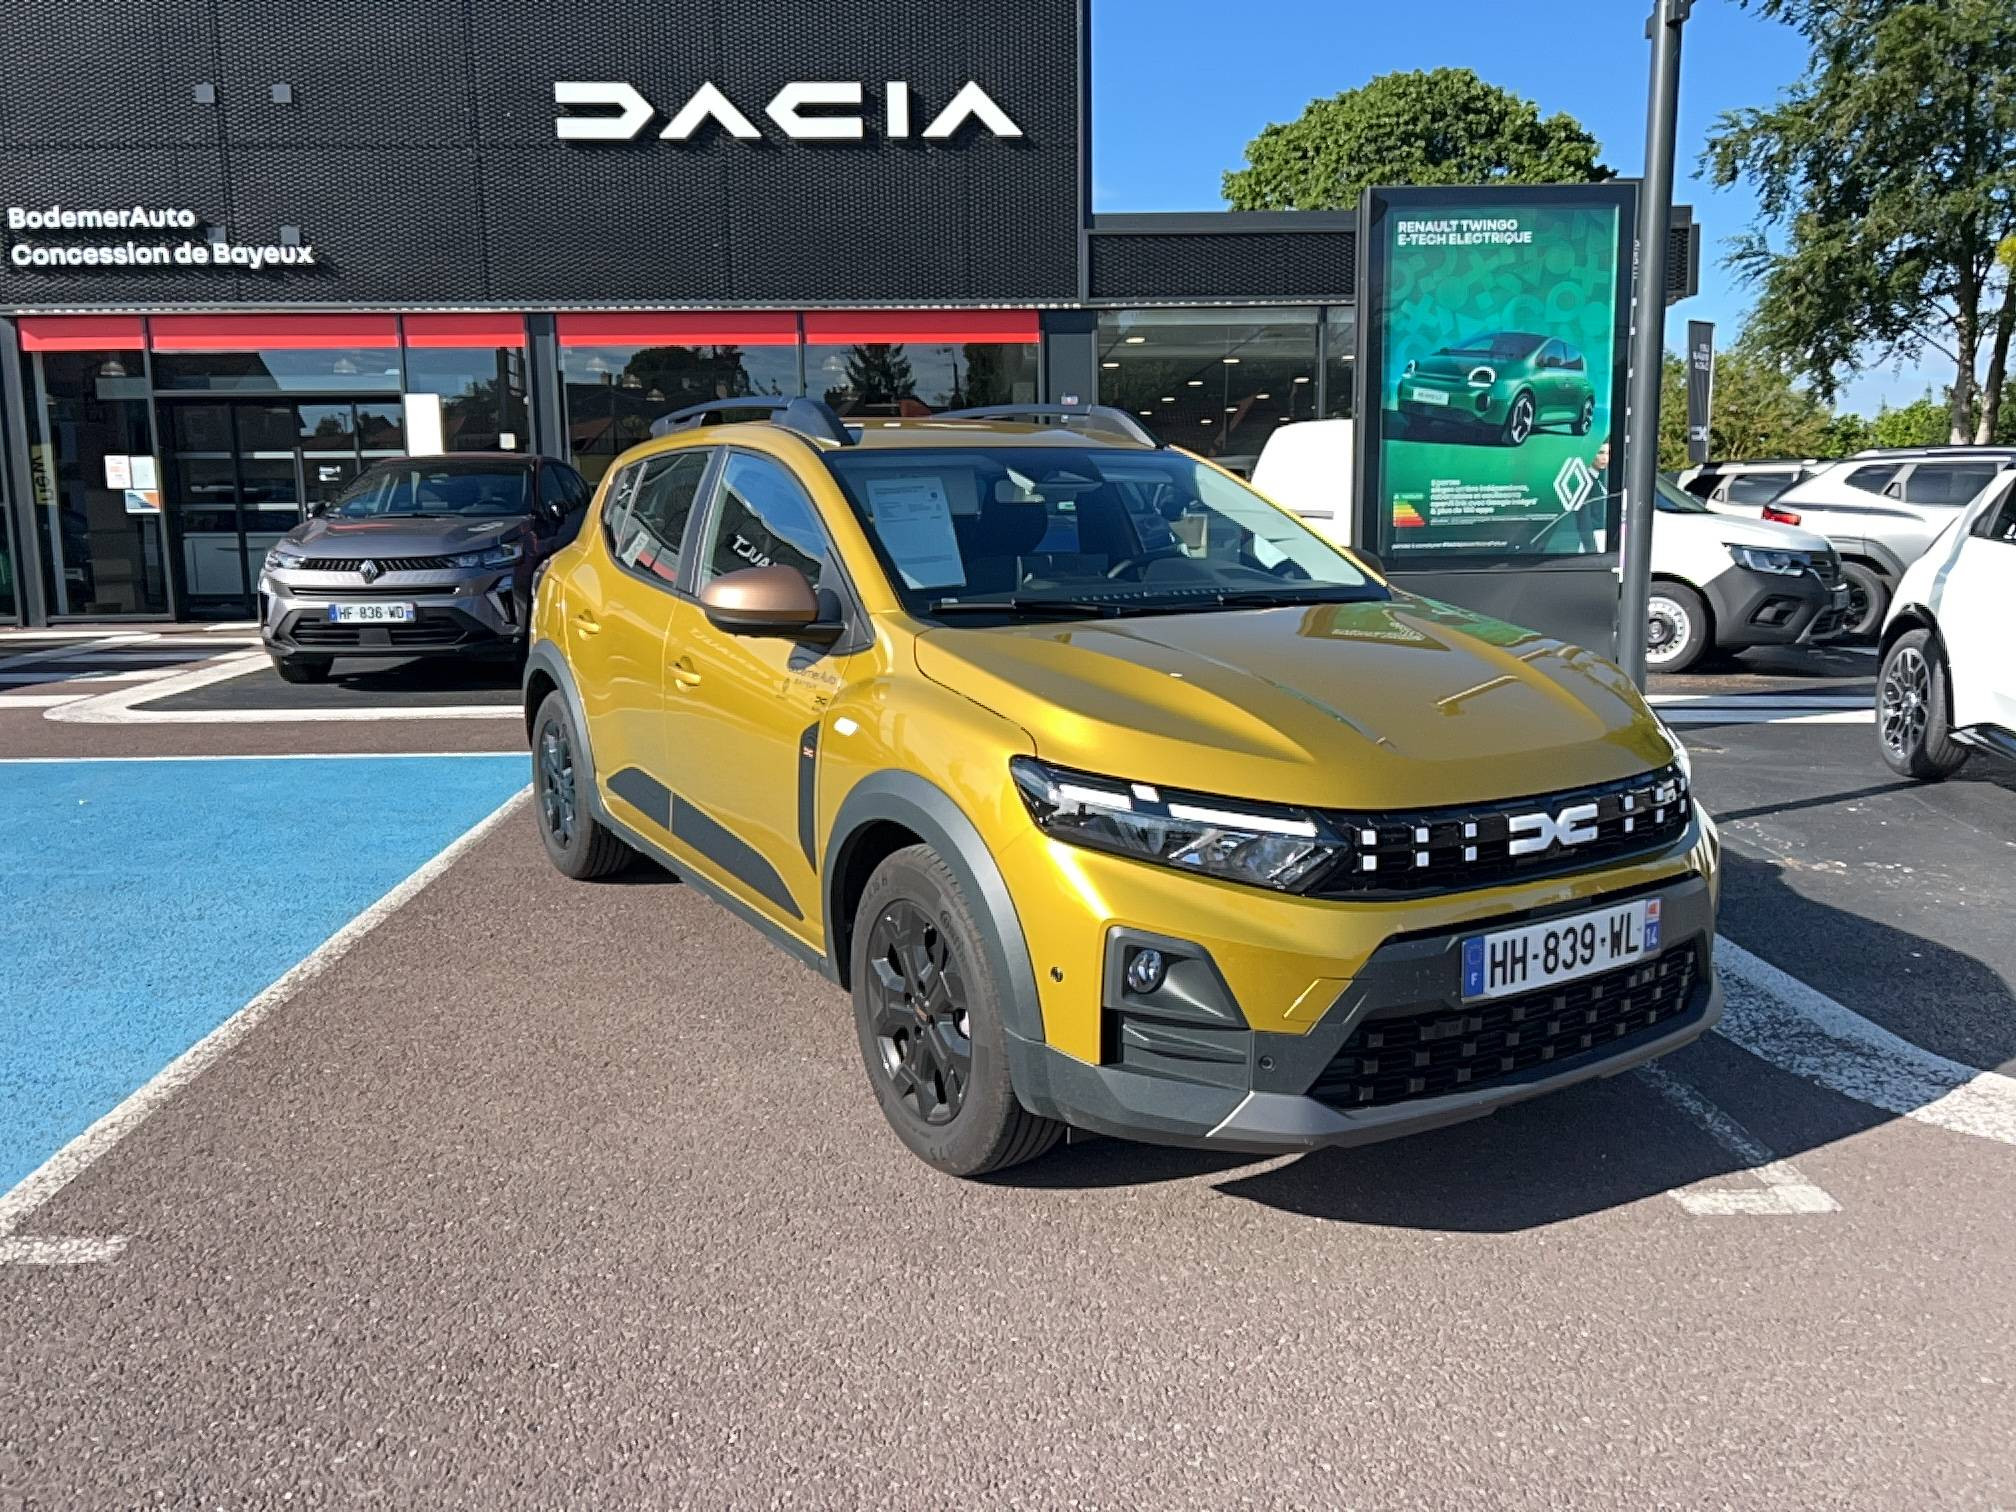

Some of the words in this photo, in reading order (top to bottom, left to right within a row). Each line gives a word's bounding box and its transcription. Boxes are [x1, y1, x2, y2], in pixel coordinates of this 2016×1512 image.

[555, 81, 1023, 140] DACIA
[7, 206, 196, 229] BodemerAuto
[1397, 220, 1459, 233] RENAULT
[1460, 219, 1518, 231] TWINGO
[1397, 233, 1446, 246] E-TECH
[1448, 231, 1533, 245] ELECTRIQUE
[10, 242, 171, 266] Concession
[174, 242, 209, 264] de
[211, 243, 315, 269] Bayeux
[1490, 912, 1639, 989] HH-839-WL
